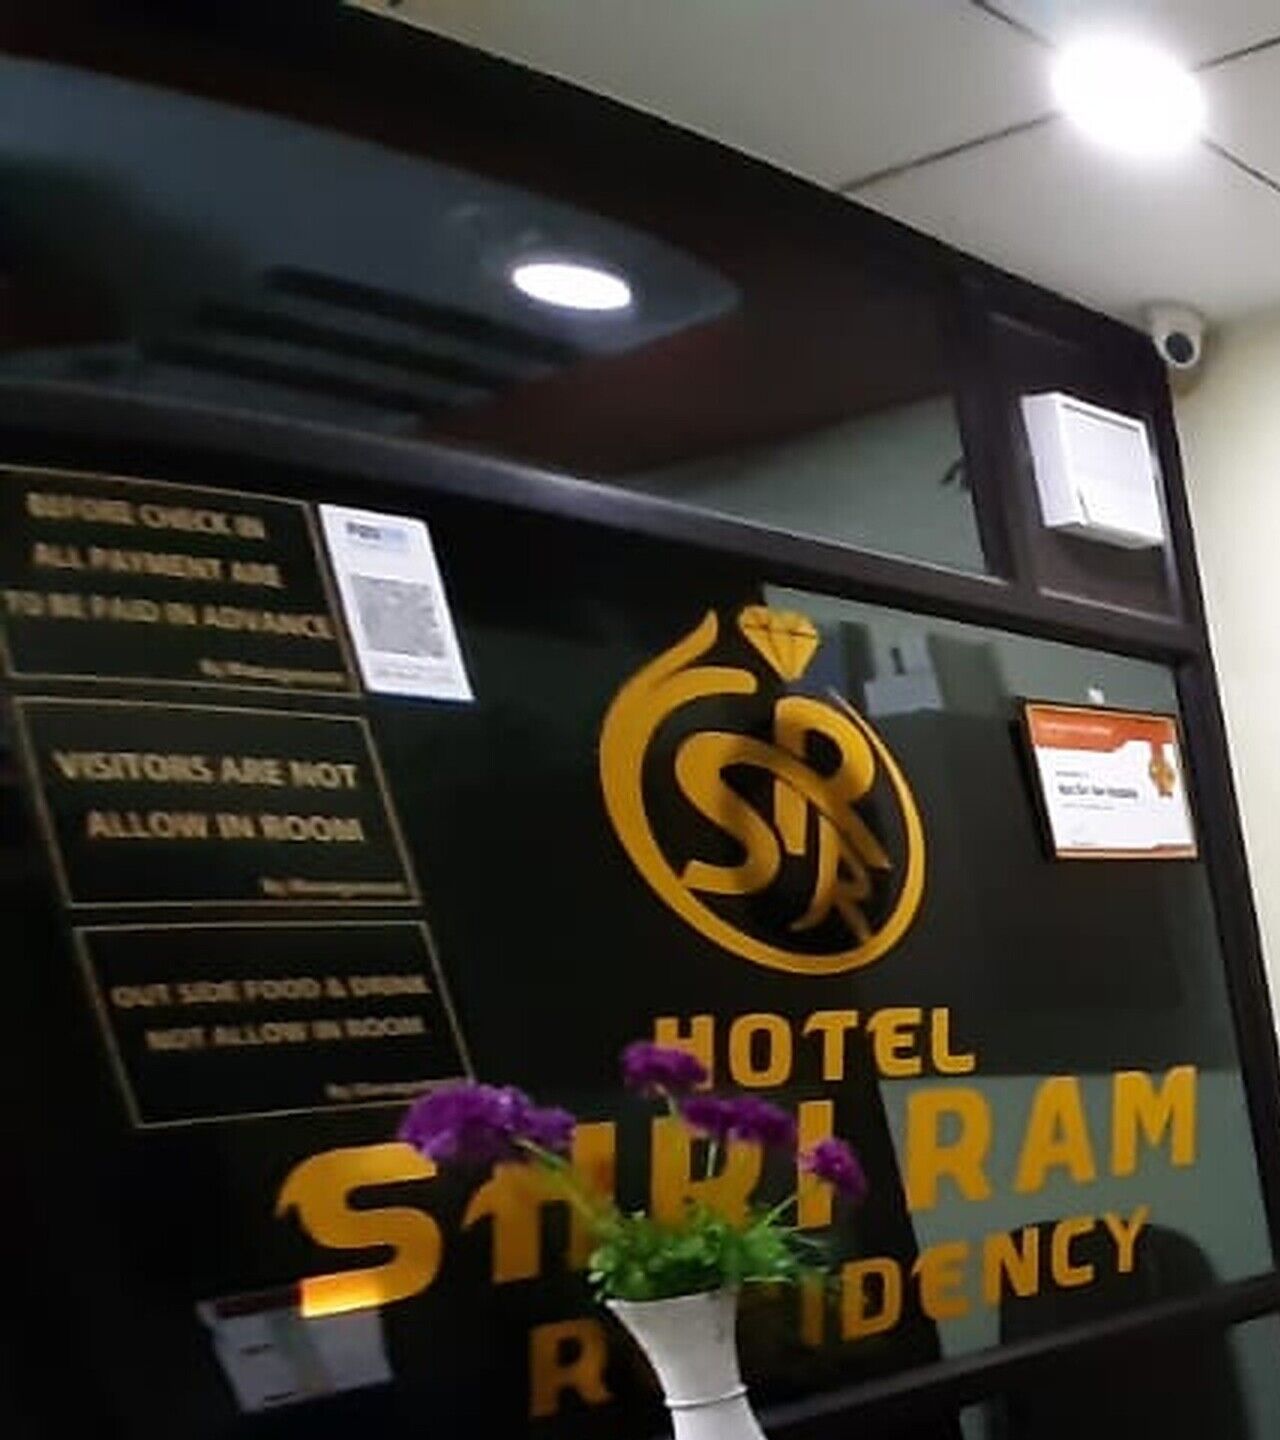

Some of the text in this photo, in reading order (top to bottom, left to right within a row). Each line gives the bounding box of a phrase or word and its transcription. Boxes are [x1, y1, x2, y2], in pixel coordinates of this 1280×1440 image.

[53, 752, 361, 790] VISITORS ARE NOT
[87, 809, 366, 842] ALLOW IN ROOM
[243, 977, 322, 1002] FOOD
[212, 1021, 309, 1047] ALLOW
[345, 1015, 428, 1038] ROOM
[654, 1006, 977, 1091] HOTEL
[905, 1064, 1199, 1212] RAM
